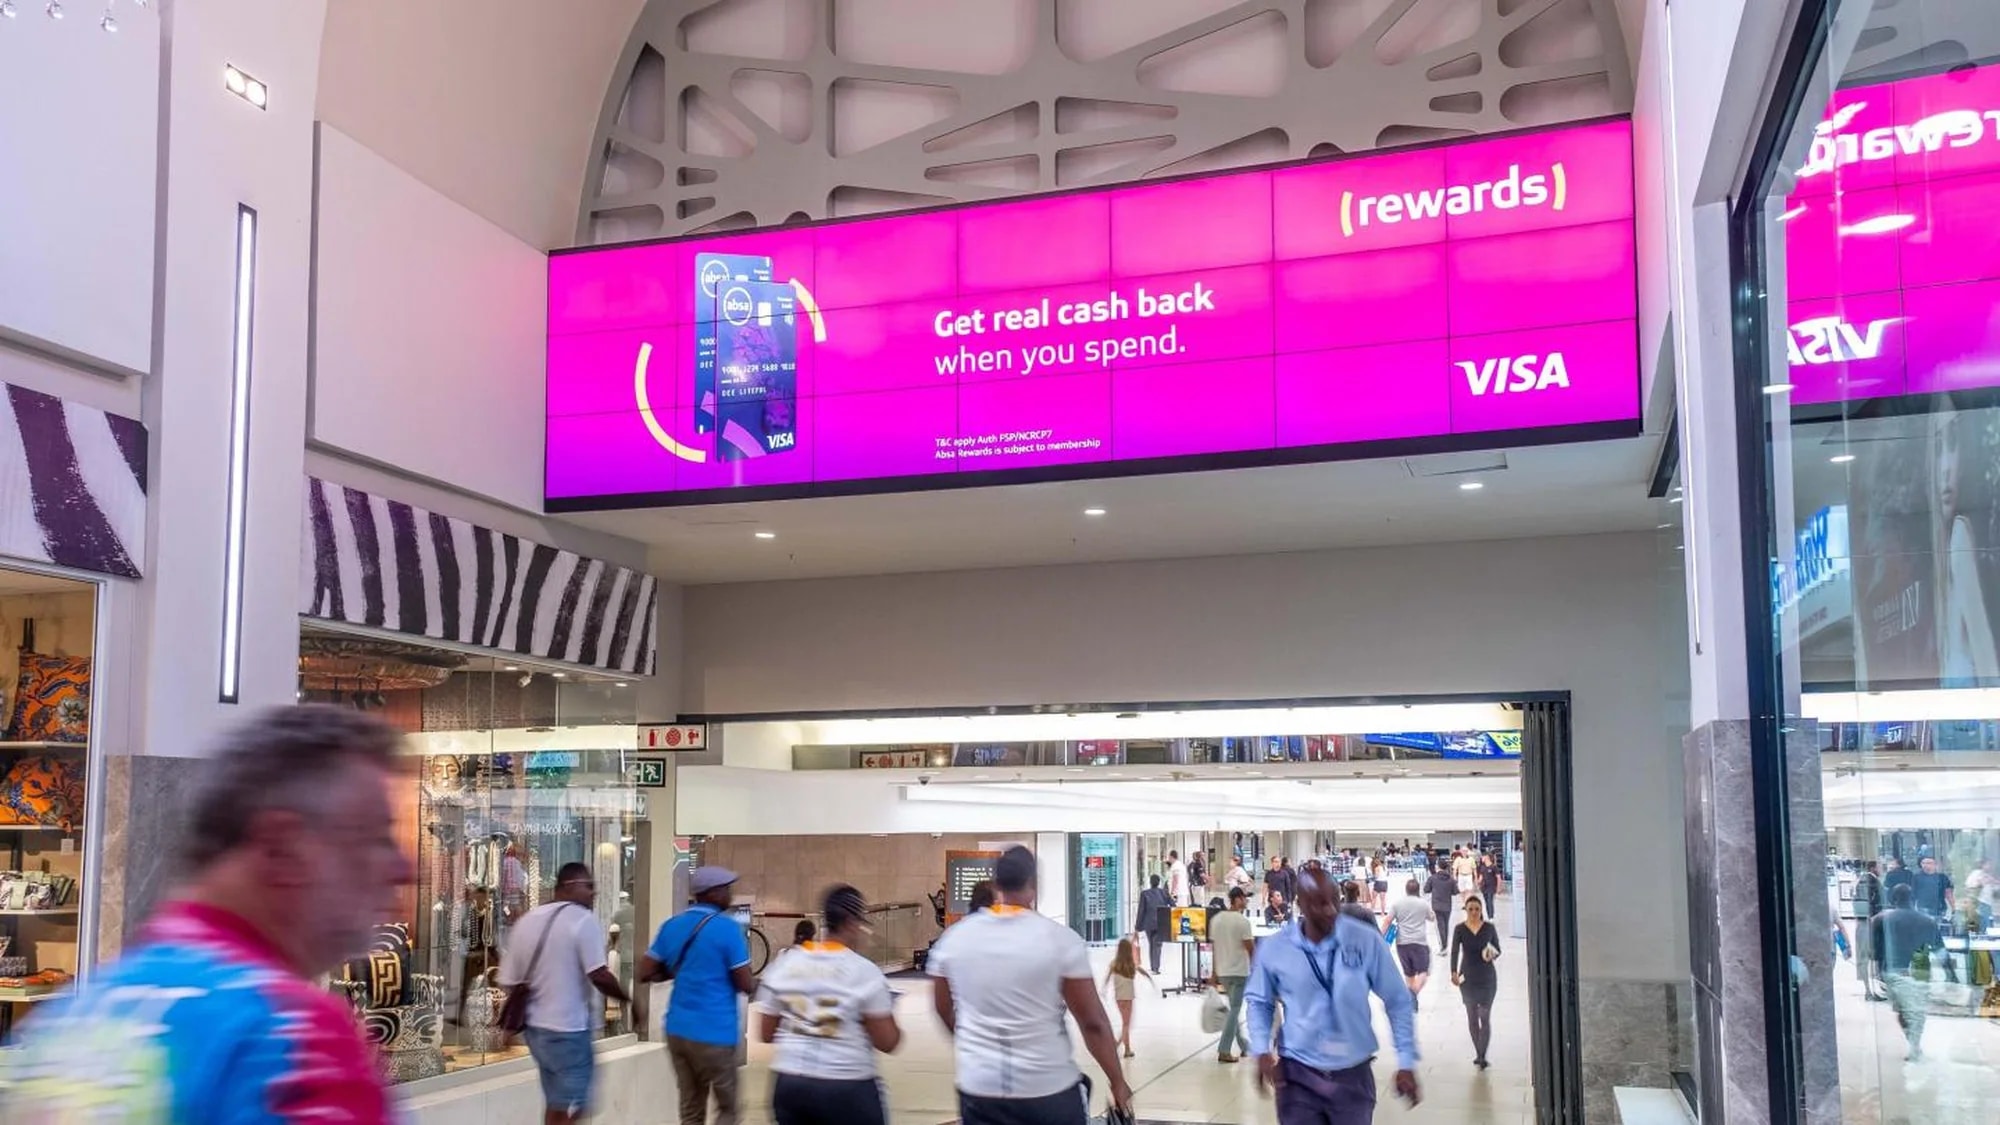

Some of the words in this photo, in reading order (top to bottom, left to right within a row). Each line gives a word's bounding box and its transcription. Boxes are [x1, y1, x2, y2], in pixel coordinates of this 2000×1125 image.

[727, 298, 749, 311] absa
[934, 310, 985, 337] Get
[993, 299, 1049, 331] real
[1058, 291, 1129, 324] cash
[1138, 281, 1215, 317] back
[934, 345, 1012, 375] when
[1020, 343, 1075, 375] you
[1084, 325, 1187, 367] spend.
[1454, 352, 1570, 396] VISA
[767, 432, 794, 449] VISA
[935, 438, 951, 447] T&C
[953, 436, 976, 447] apply
[977, 434, 998, 445] Auth
[999, 429, 1053, 442] FSP/NCRCP7
[935, 450, 955, 459] Absa
[958, 446, 993, 457] Rewards
[994, 446, 1002, 454] is
[1003, 443, 1034, 455] subject
[1036, 442, 1046, 451] to
[1047, 438, 1101, 450] membership
